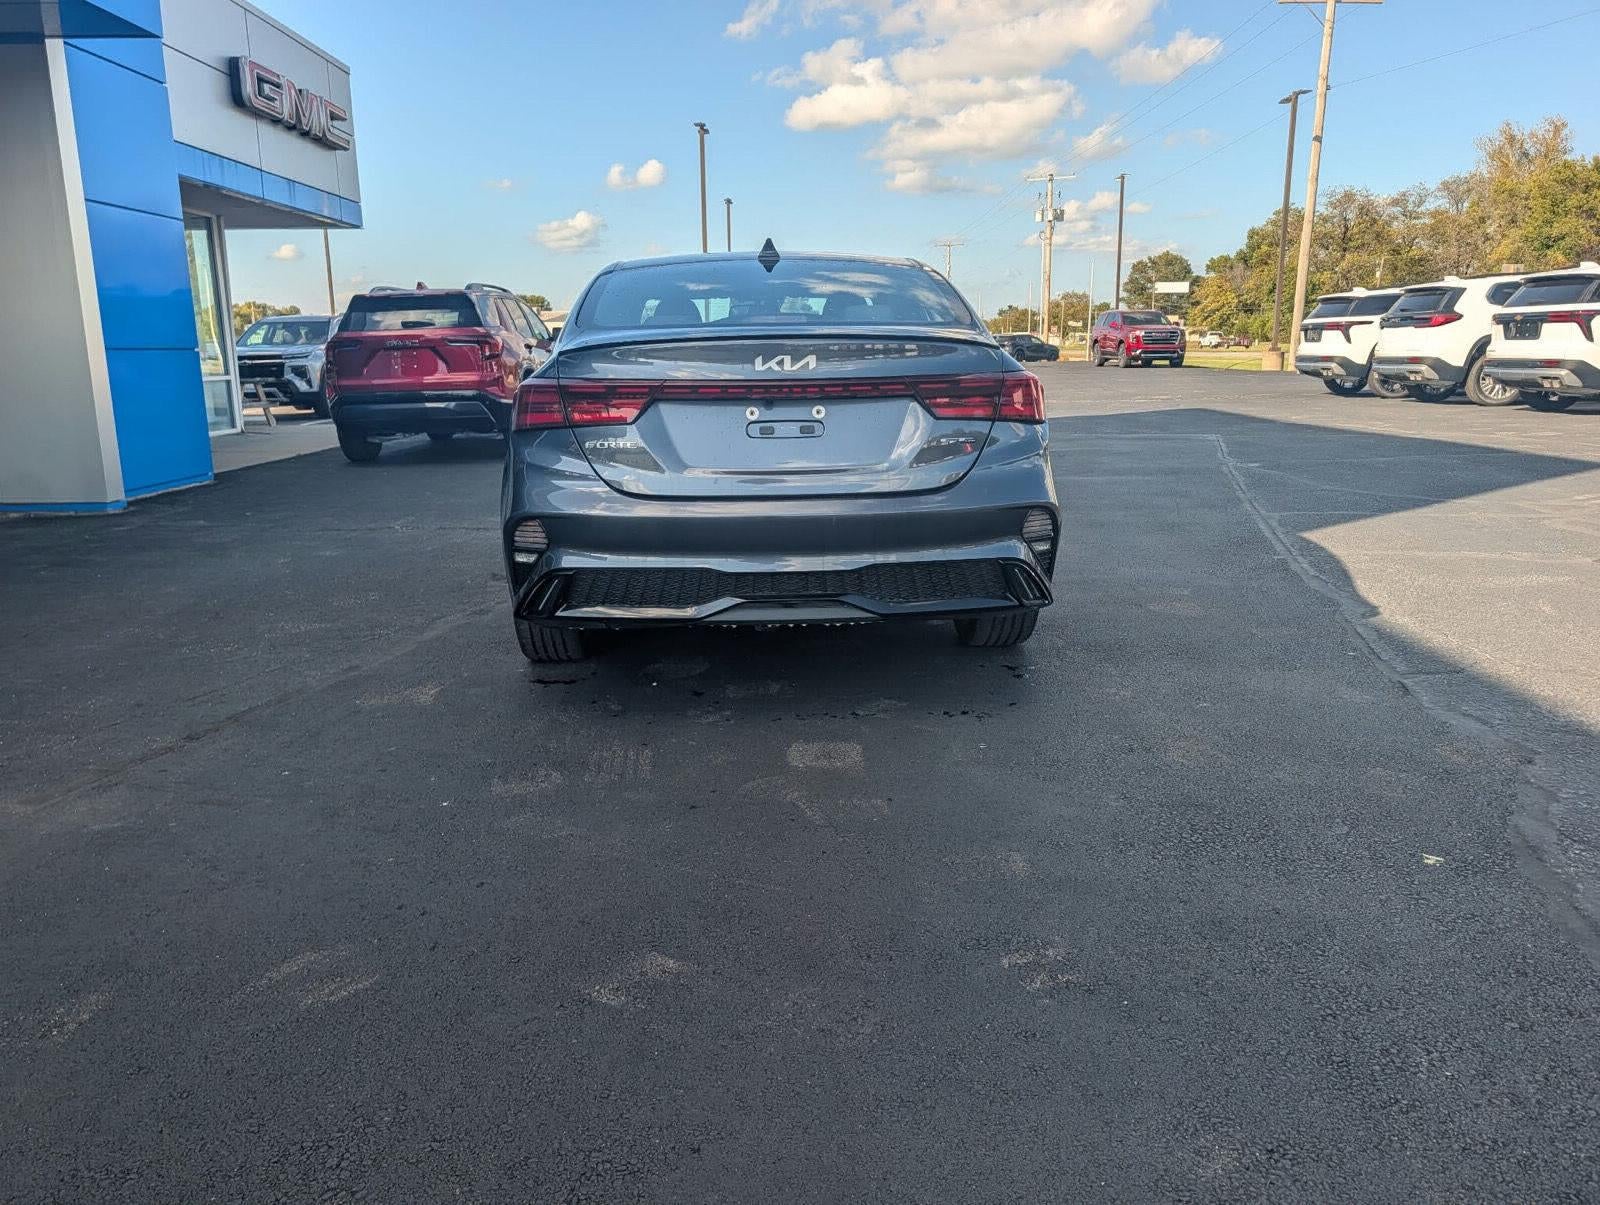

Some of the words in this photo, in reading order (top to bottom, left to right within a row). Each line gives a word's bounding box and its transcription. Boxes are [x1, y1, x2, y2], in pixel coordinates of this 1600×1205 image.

[231, 56, 351, 151] GMC
[754, 354, 817, 371] KIA
[584, 441, 638, 449] FORTE
